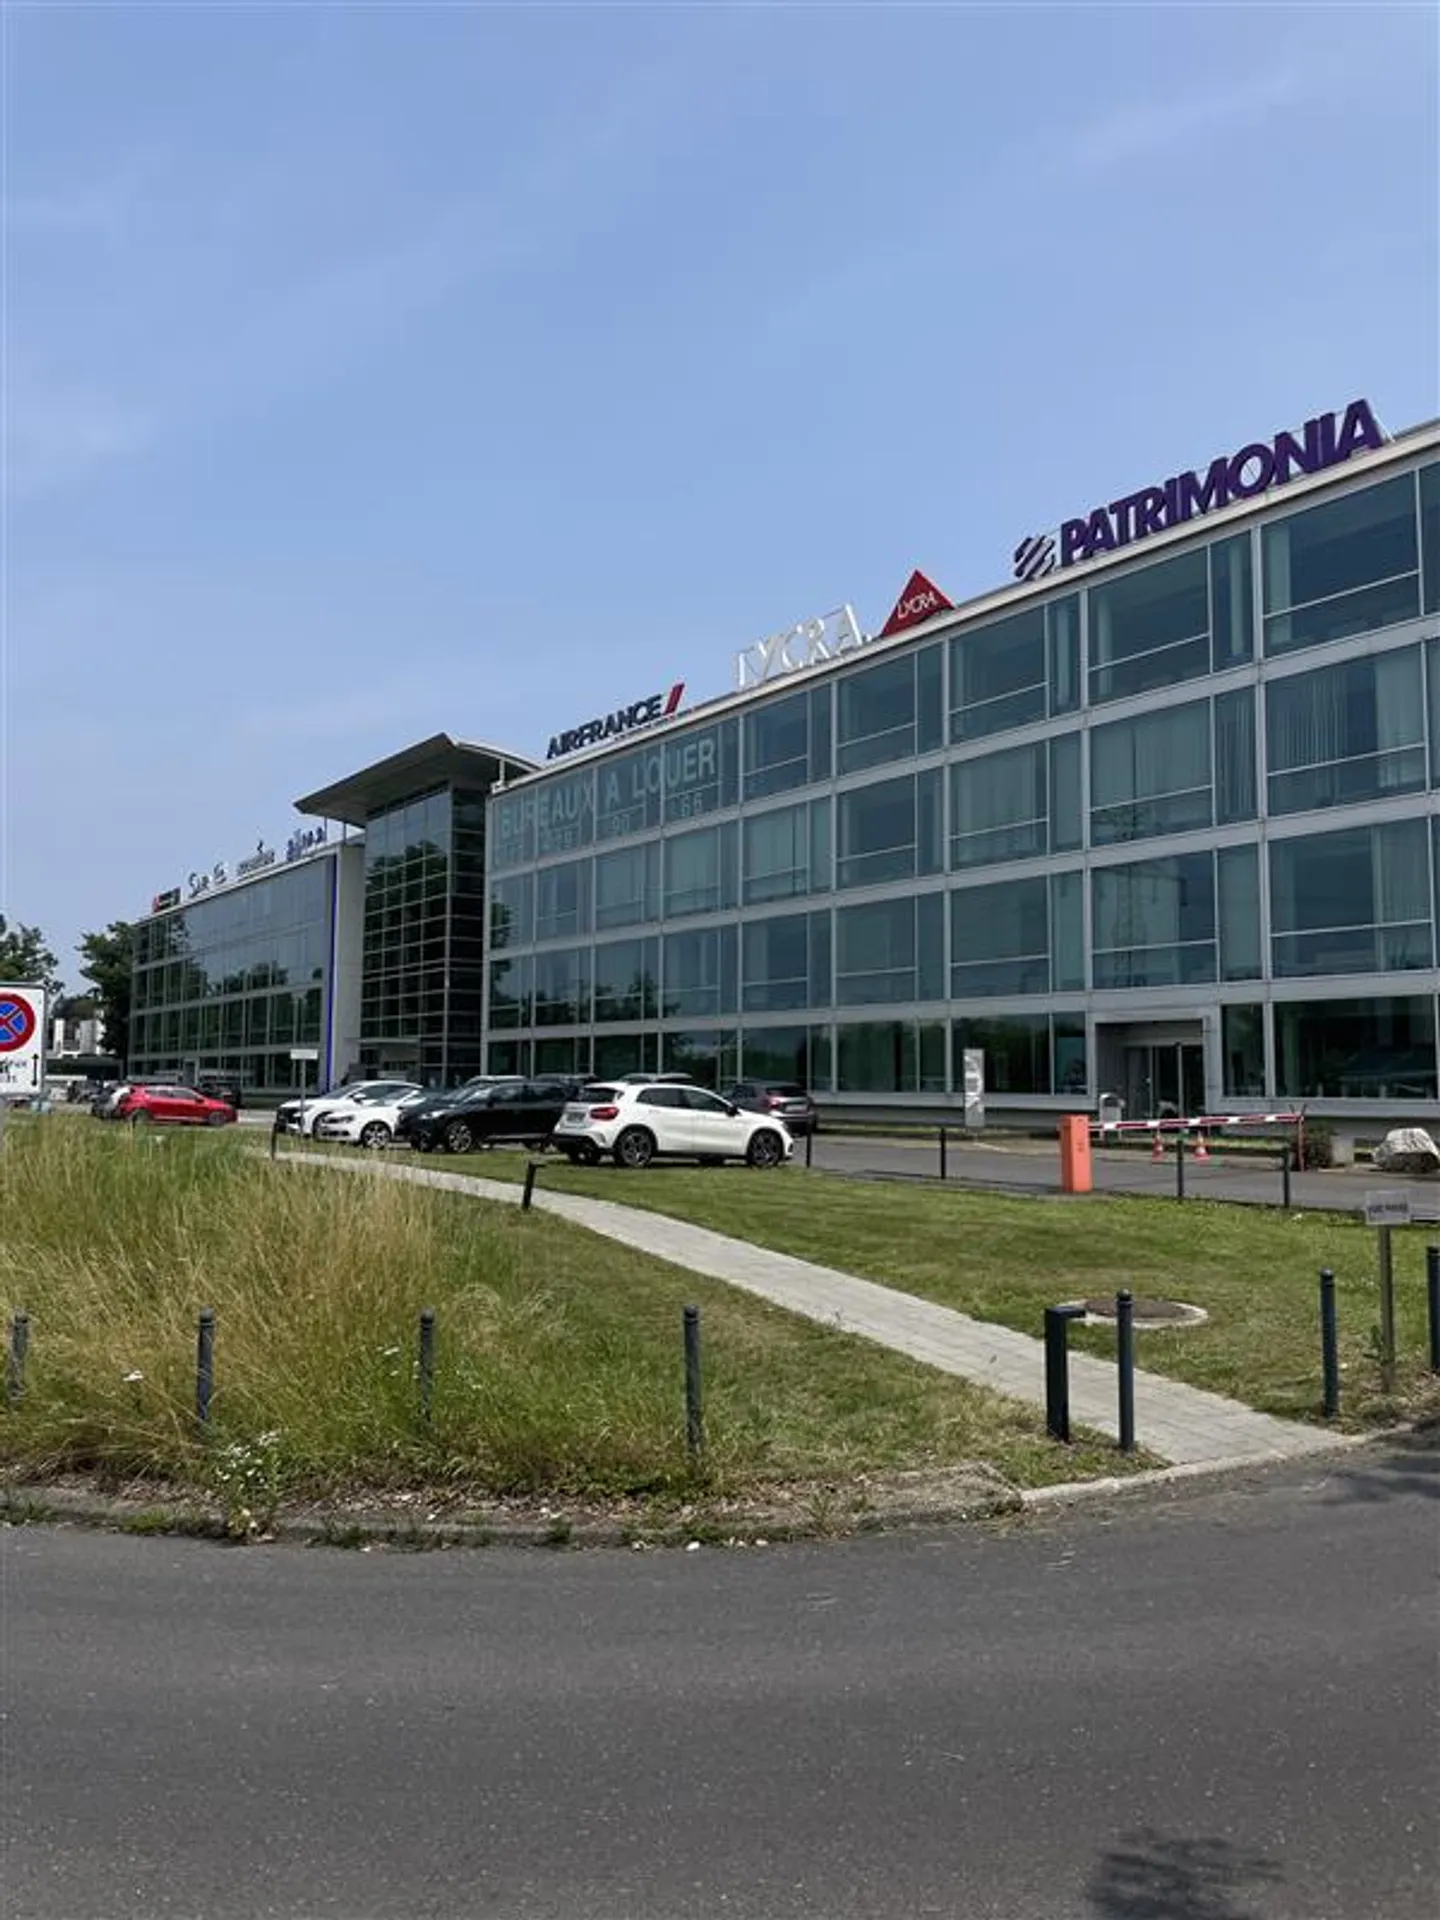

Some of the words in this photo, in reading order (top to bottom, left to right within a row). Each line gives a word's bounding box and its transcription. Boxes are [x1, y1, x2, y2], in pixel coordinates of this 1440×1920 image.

[1061, 398, 1384, 567] PATRIMONIA
[735, 602, 872, 688] LYCRA
[546, 694, 663, 760] AIRFRANCE
[632, 738, 716, 799] LOUER
